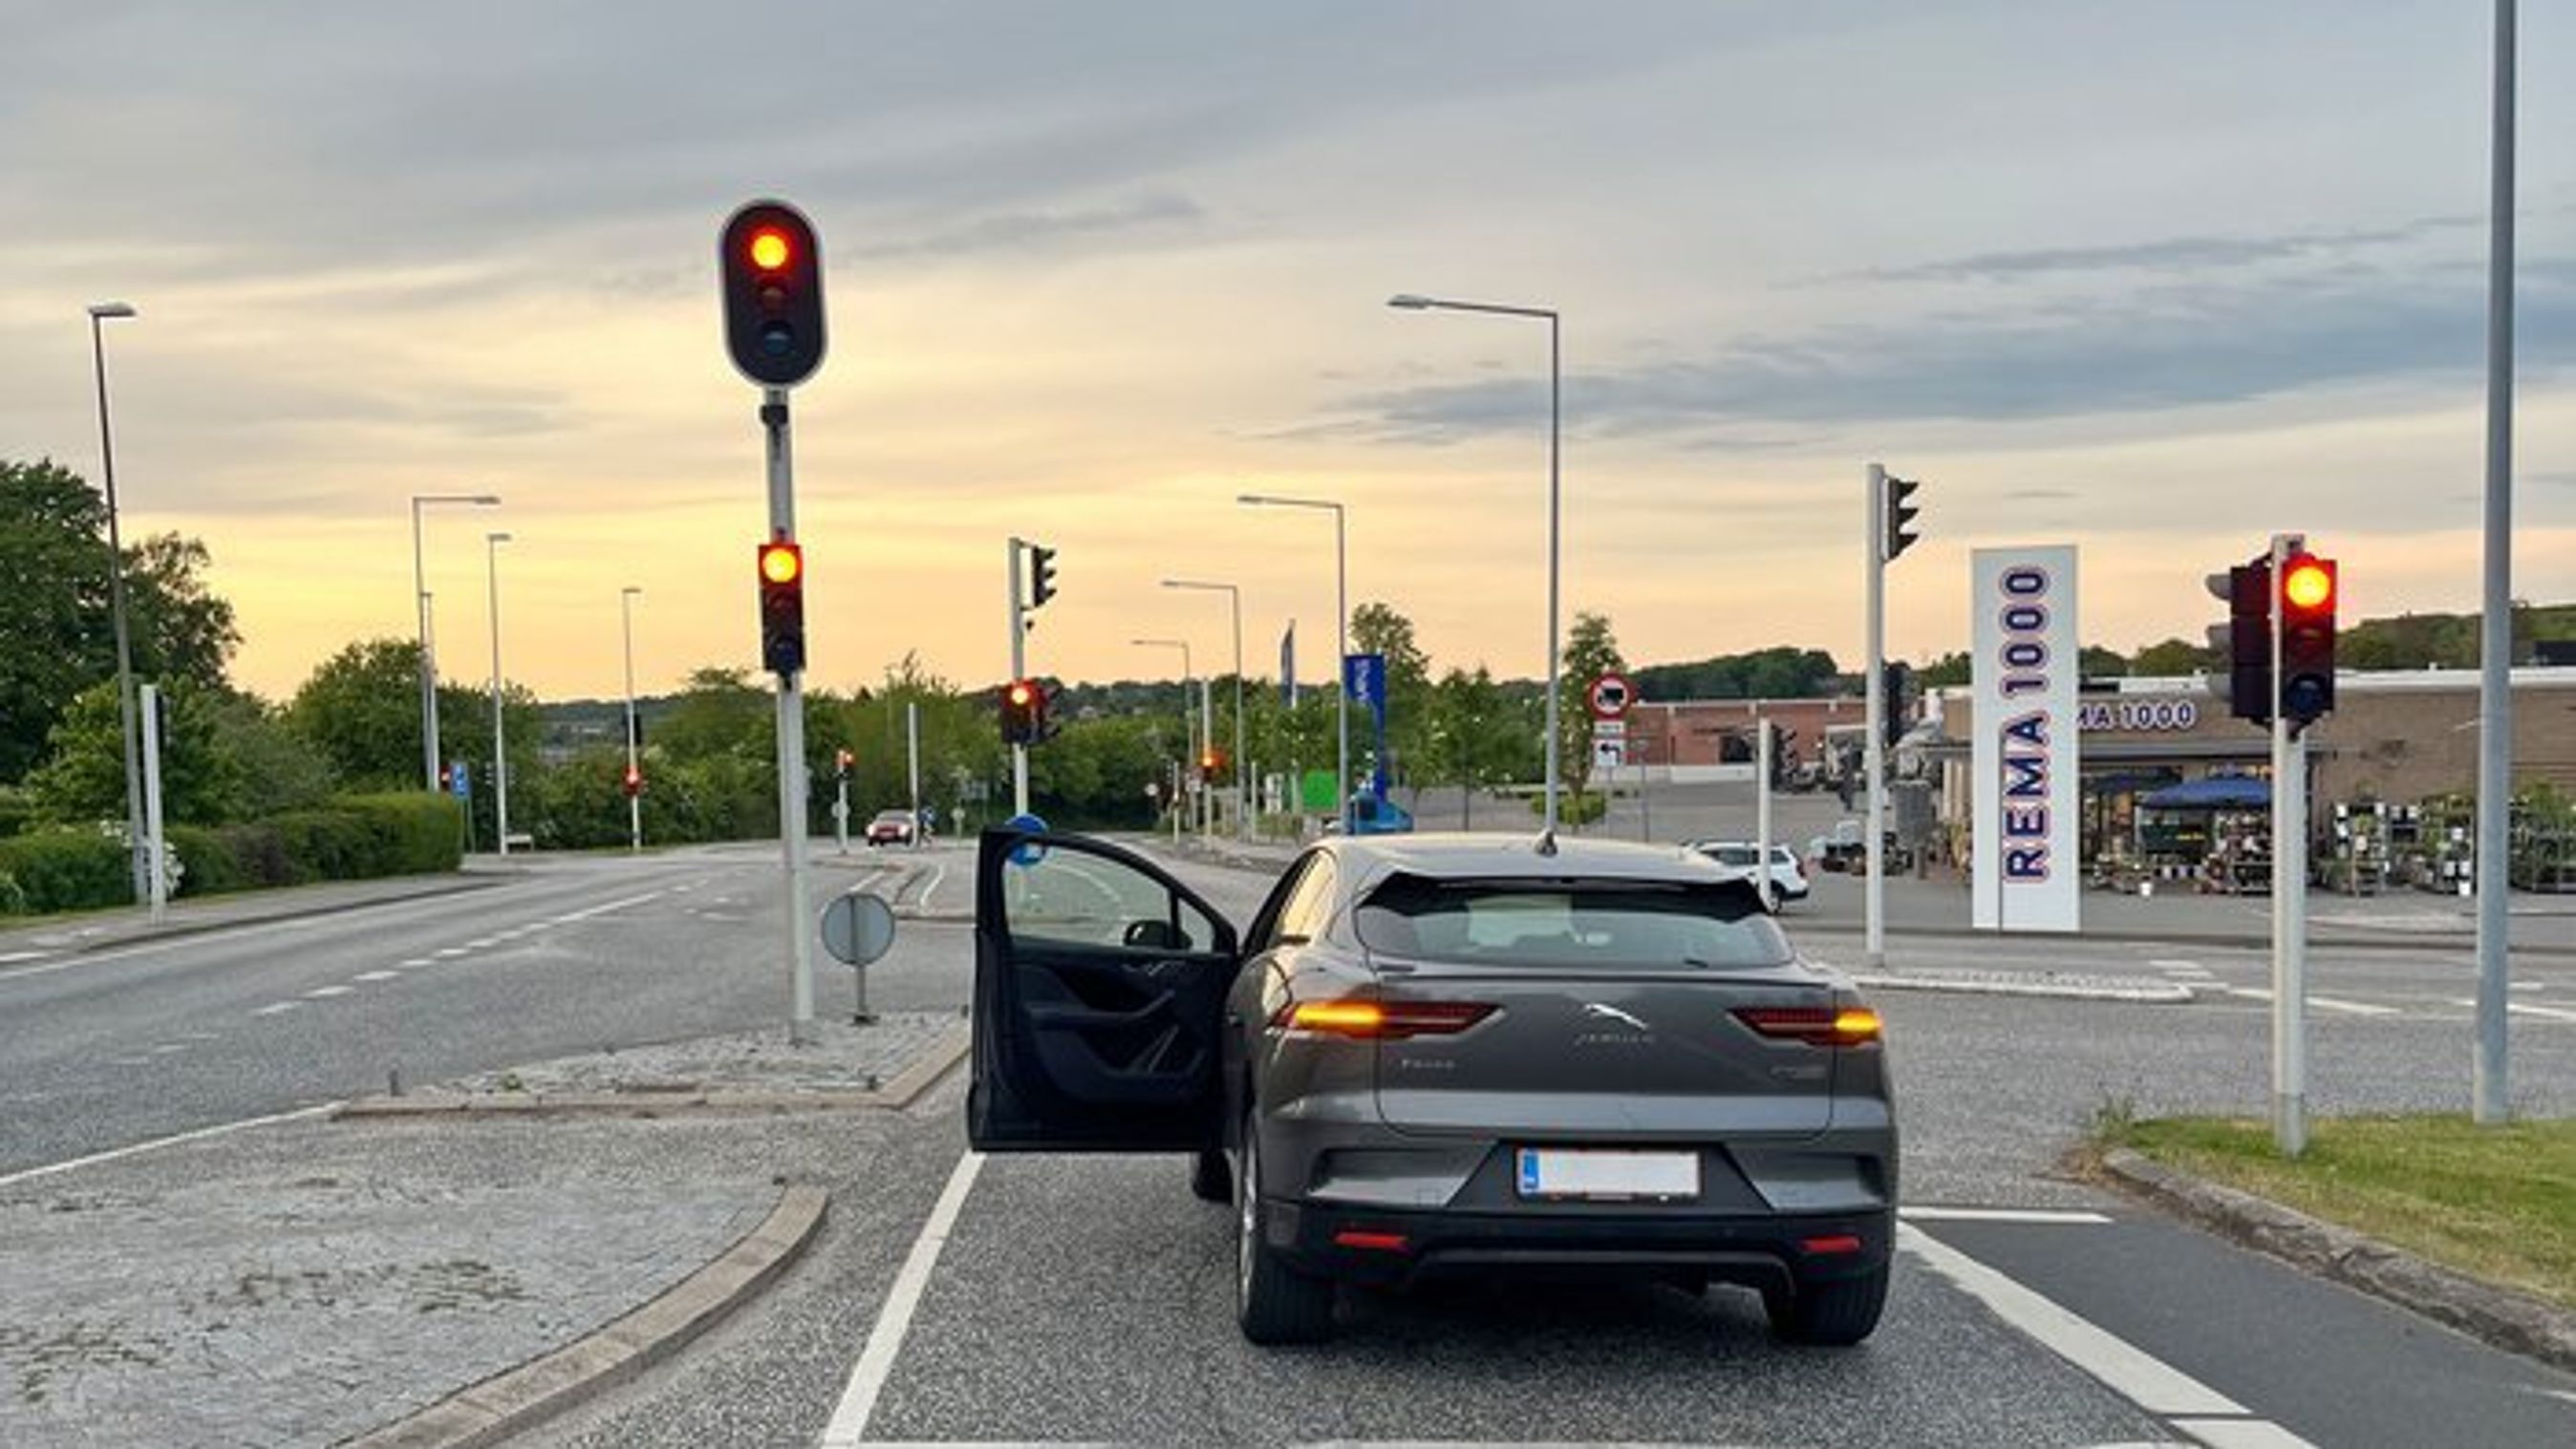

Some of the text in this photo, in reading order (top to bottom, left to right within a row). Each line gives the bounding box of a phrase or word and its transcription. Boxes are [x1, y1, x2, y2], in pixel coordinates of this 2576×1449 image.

[2003, 569, 2047, 878] REMA 1000
[2121, 702, 2192, 726] 1000
